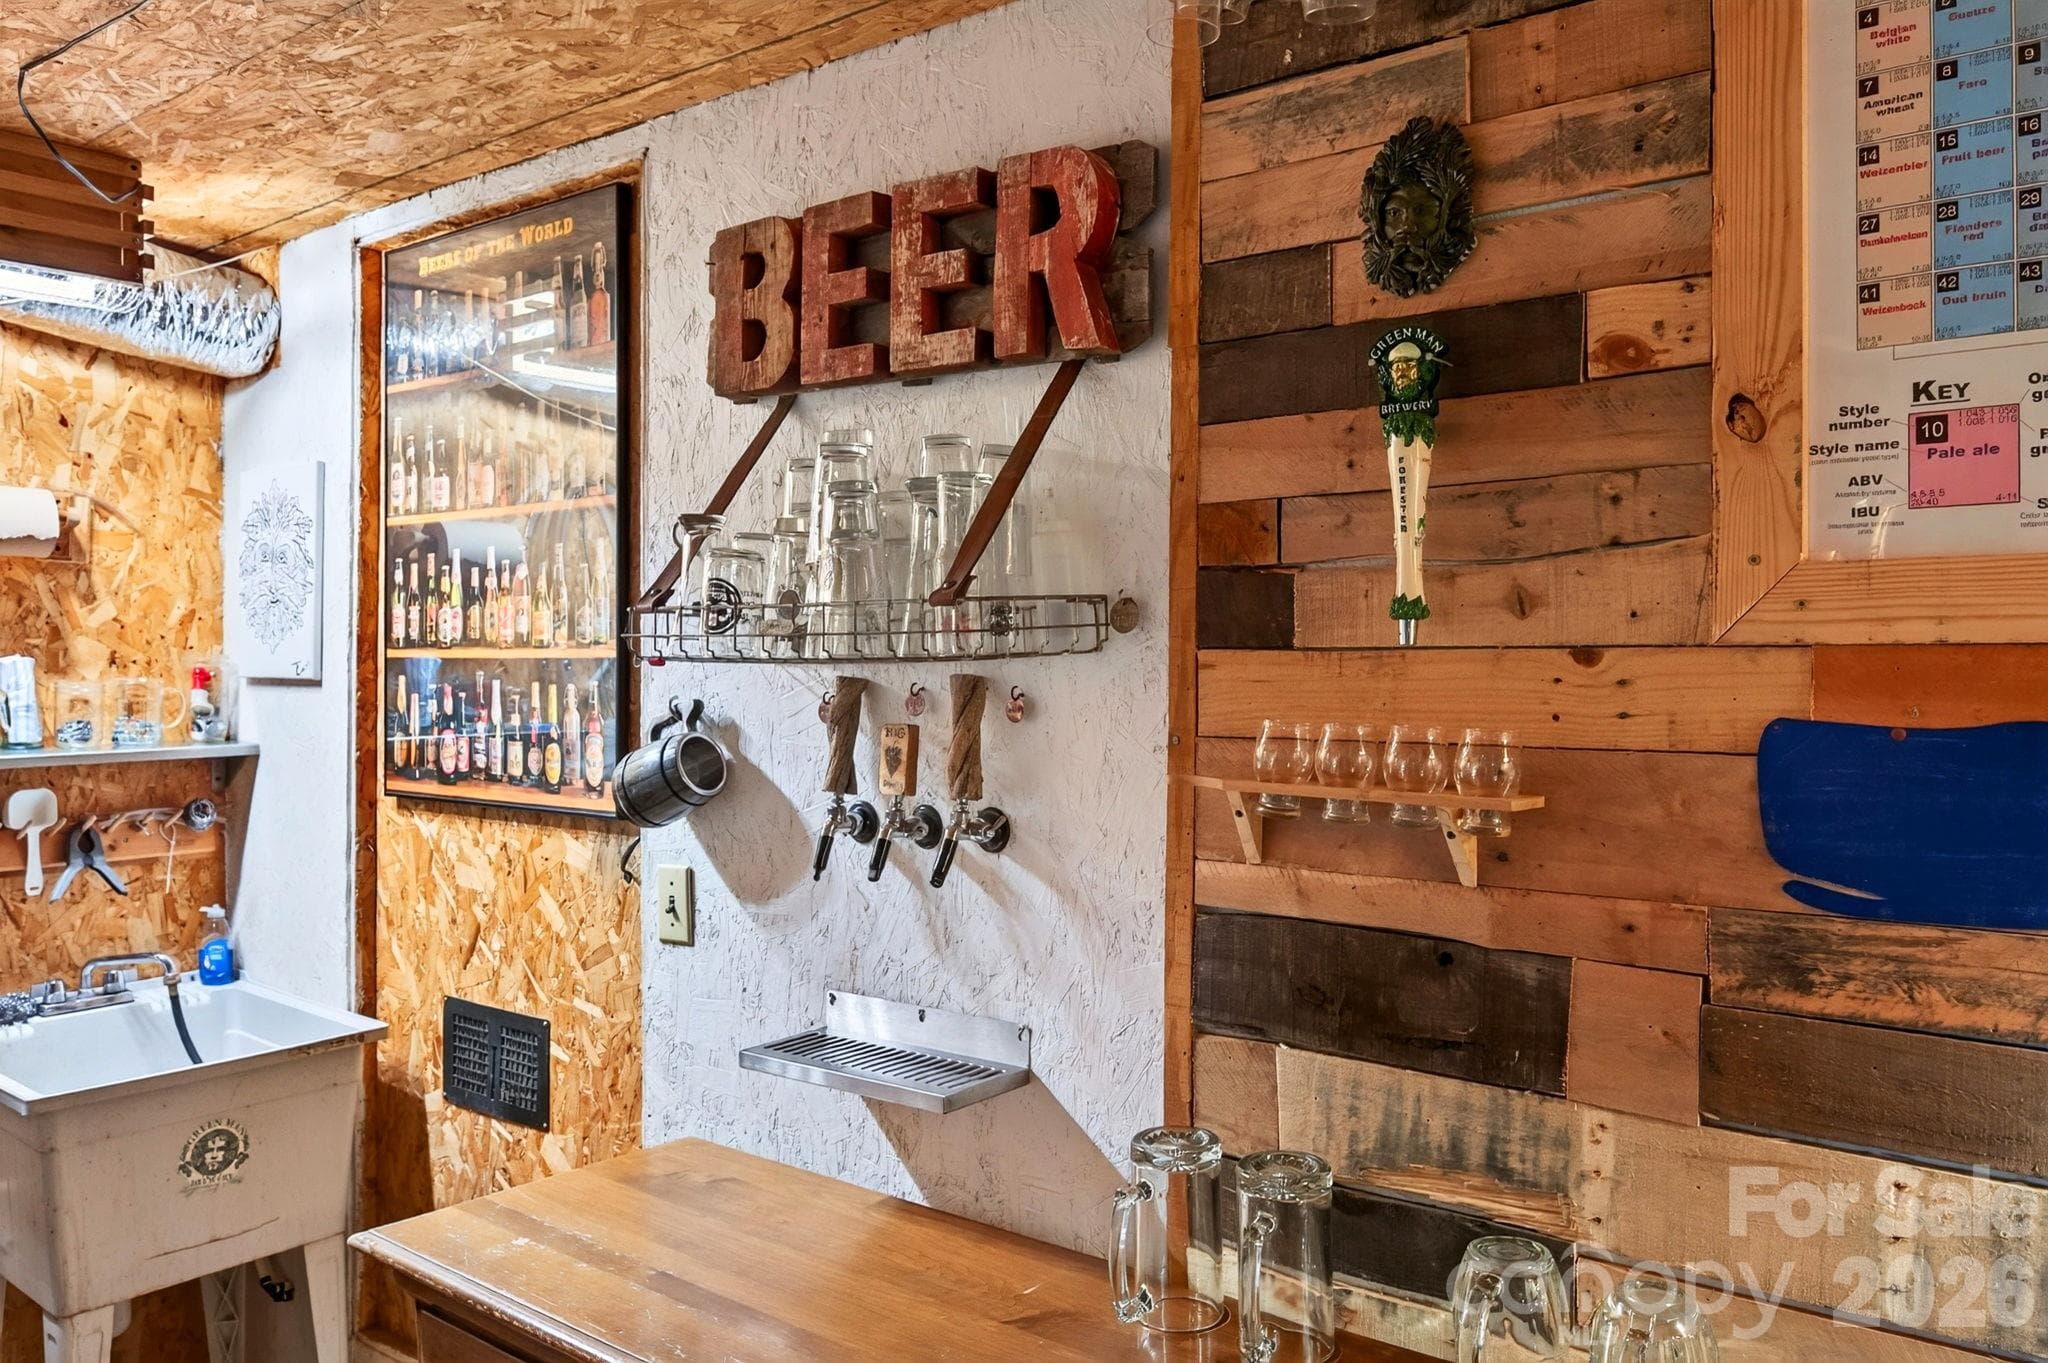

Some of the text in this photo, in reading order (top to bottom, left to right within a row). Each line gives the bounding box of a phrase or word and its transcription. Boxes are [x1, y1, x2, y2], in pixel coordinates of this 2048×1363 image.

[1863, 11, 1873, 24] 4
[1869, 23, 1917, 40] Belgian
[1875, 35, 1911, 49] white
[2024, 48, 2035, 60] 9
[1942, 65, 1952, 77] 8
[1863, 81, 1873, 93] 7
[1863, 91, 1923, 110] American
[1876, 102, 1914, 117] wheat
[2021, 118, 2039, 132] 16
[1861, 150, 1877, 161] 14
[1941, 152, 1971, 165] Fruit
[2021, 192, 2039, 206] 29
[1860, 220, 1877, 232] 27
[1945, 220, 2002, 234] Flanders
[1963, 232, 1984, 242] red
[418, 216, 574, 278] BEERS OF THE WORLD
[714, 143, 1122, 398] BEER
[2021, 264, 2040, 278] 43
[1938, 275, 1957, 288] 42
[1860, 287, 1877, 299] 41
[1942, 290, 2007, 306] Oud bruin
[1370, 327, 1444, 360] GREEN MAN
[1380, 399, 1433, 416] BREWERY
[1839, 404, 1880, 418] Style
[1828, 418, 1891, 432] number
[1921, 420, 1944, 438] 10
[1809, 440, 1900, 457] Style name
[1927, 443, 2001, 459] Pale ale
[1848, 474, 1883, 487] ABV
[1398, 456, 1408, 533] FORESTER
[1851, 506, 1880, 518] IBU
